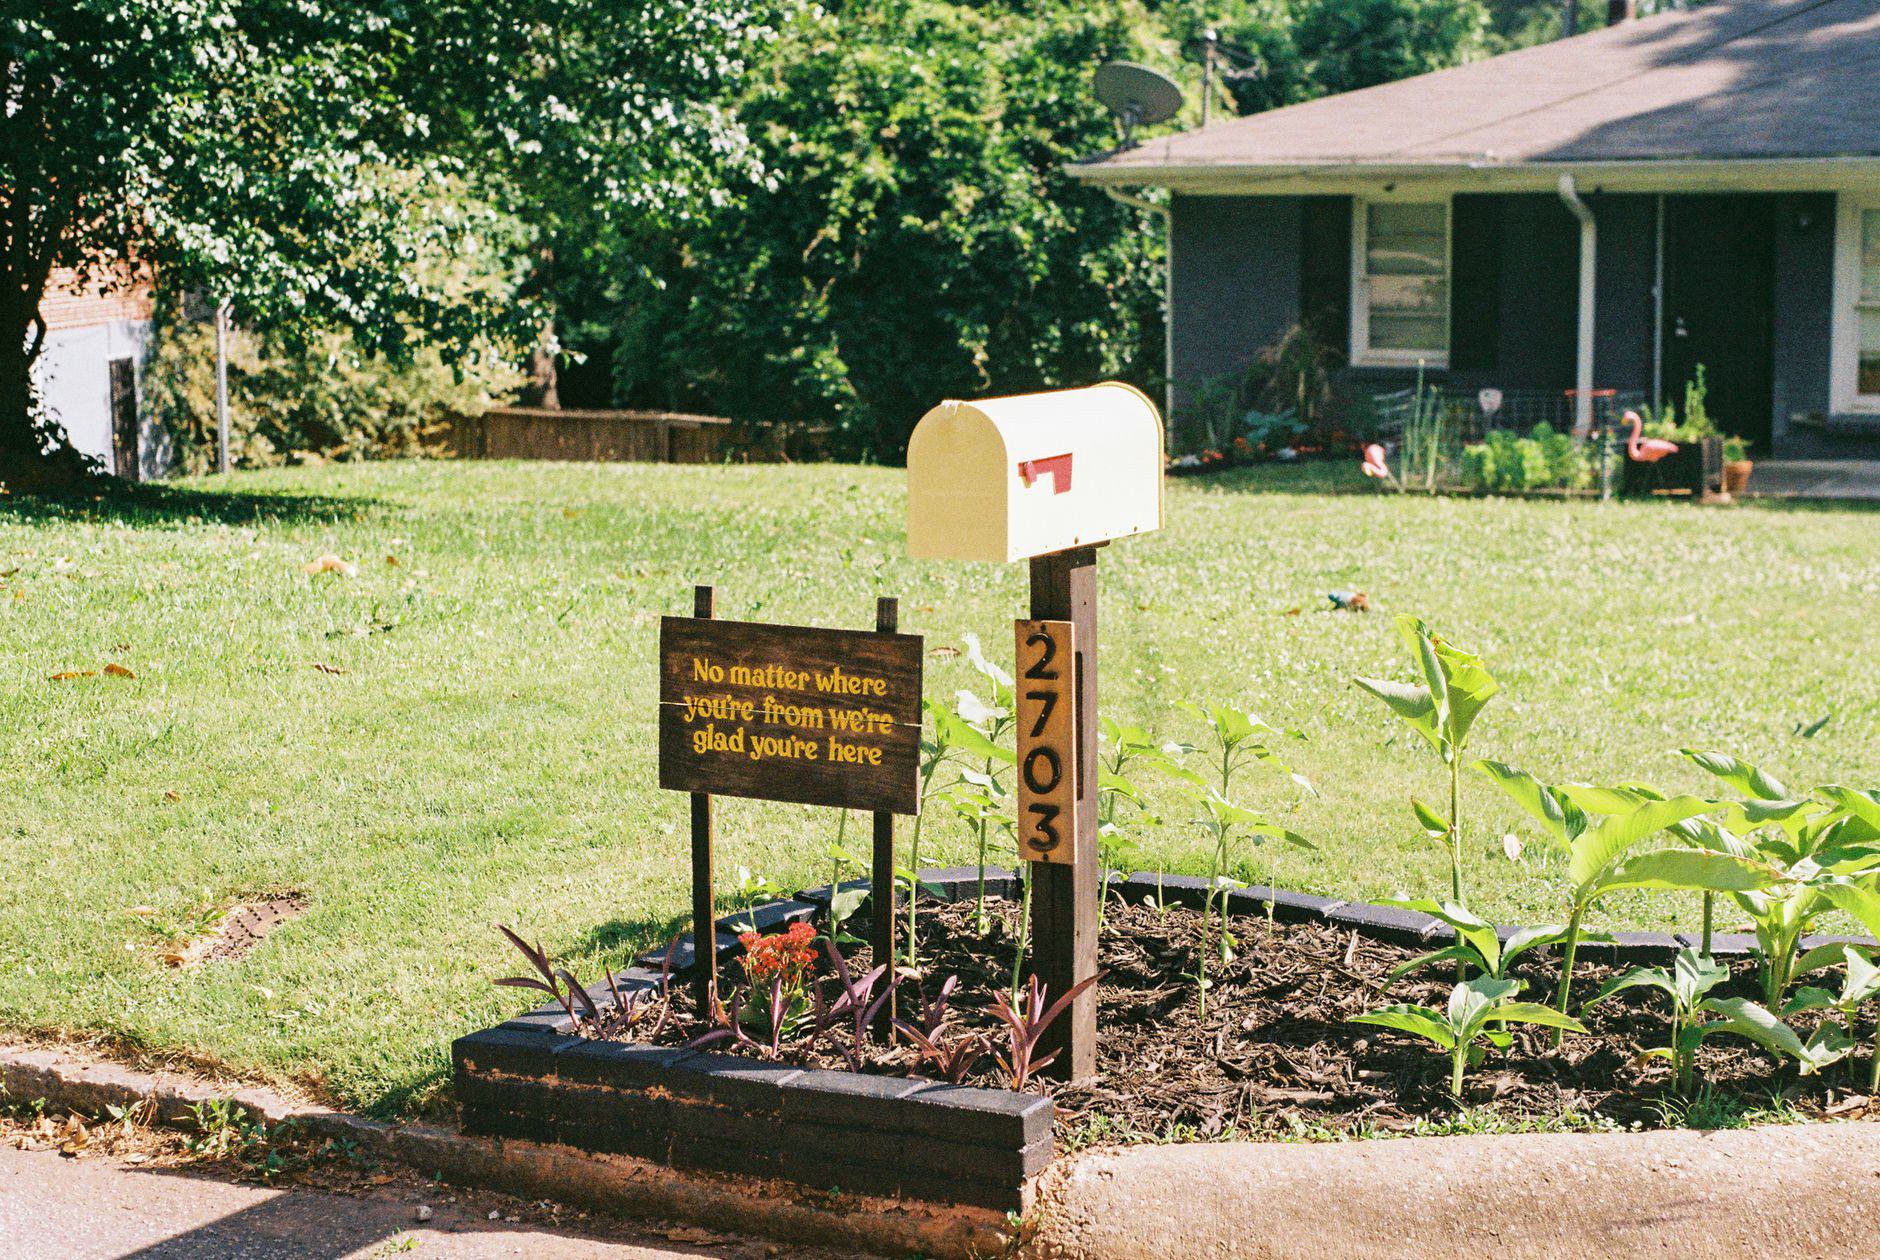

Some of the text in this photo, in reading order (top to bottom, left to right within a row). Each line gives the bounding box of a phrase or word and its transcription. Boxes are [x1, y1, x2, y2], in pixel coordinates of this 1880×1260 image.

[693, 658, 888, 696] No matter where
[684, 694, 896, 734] you're from we're
[693, 724, 883, 766] glad you're here
[1023, 633, 1061, 852] 27703
